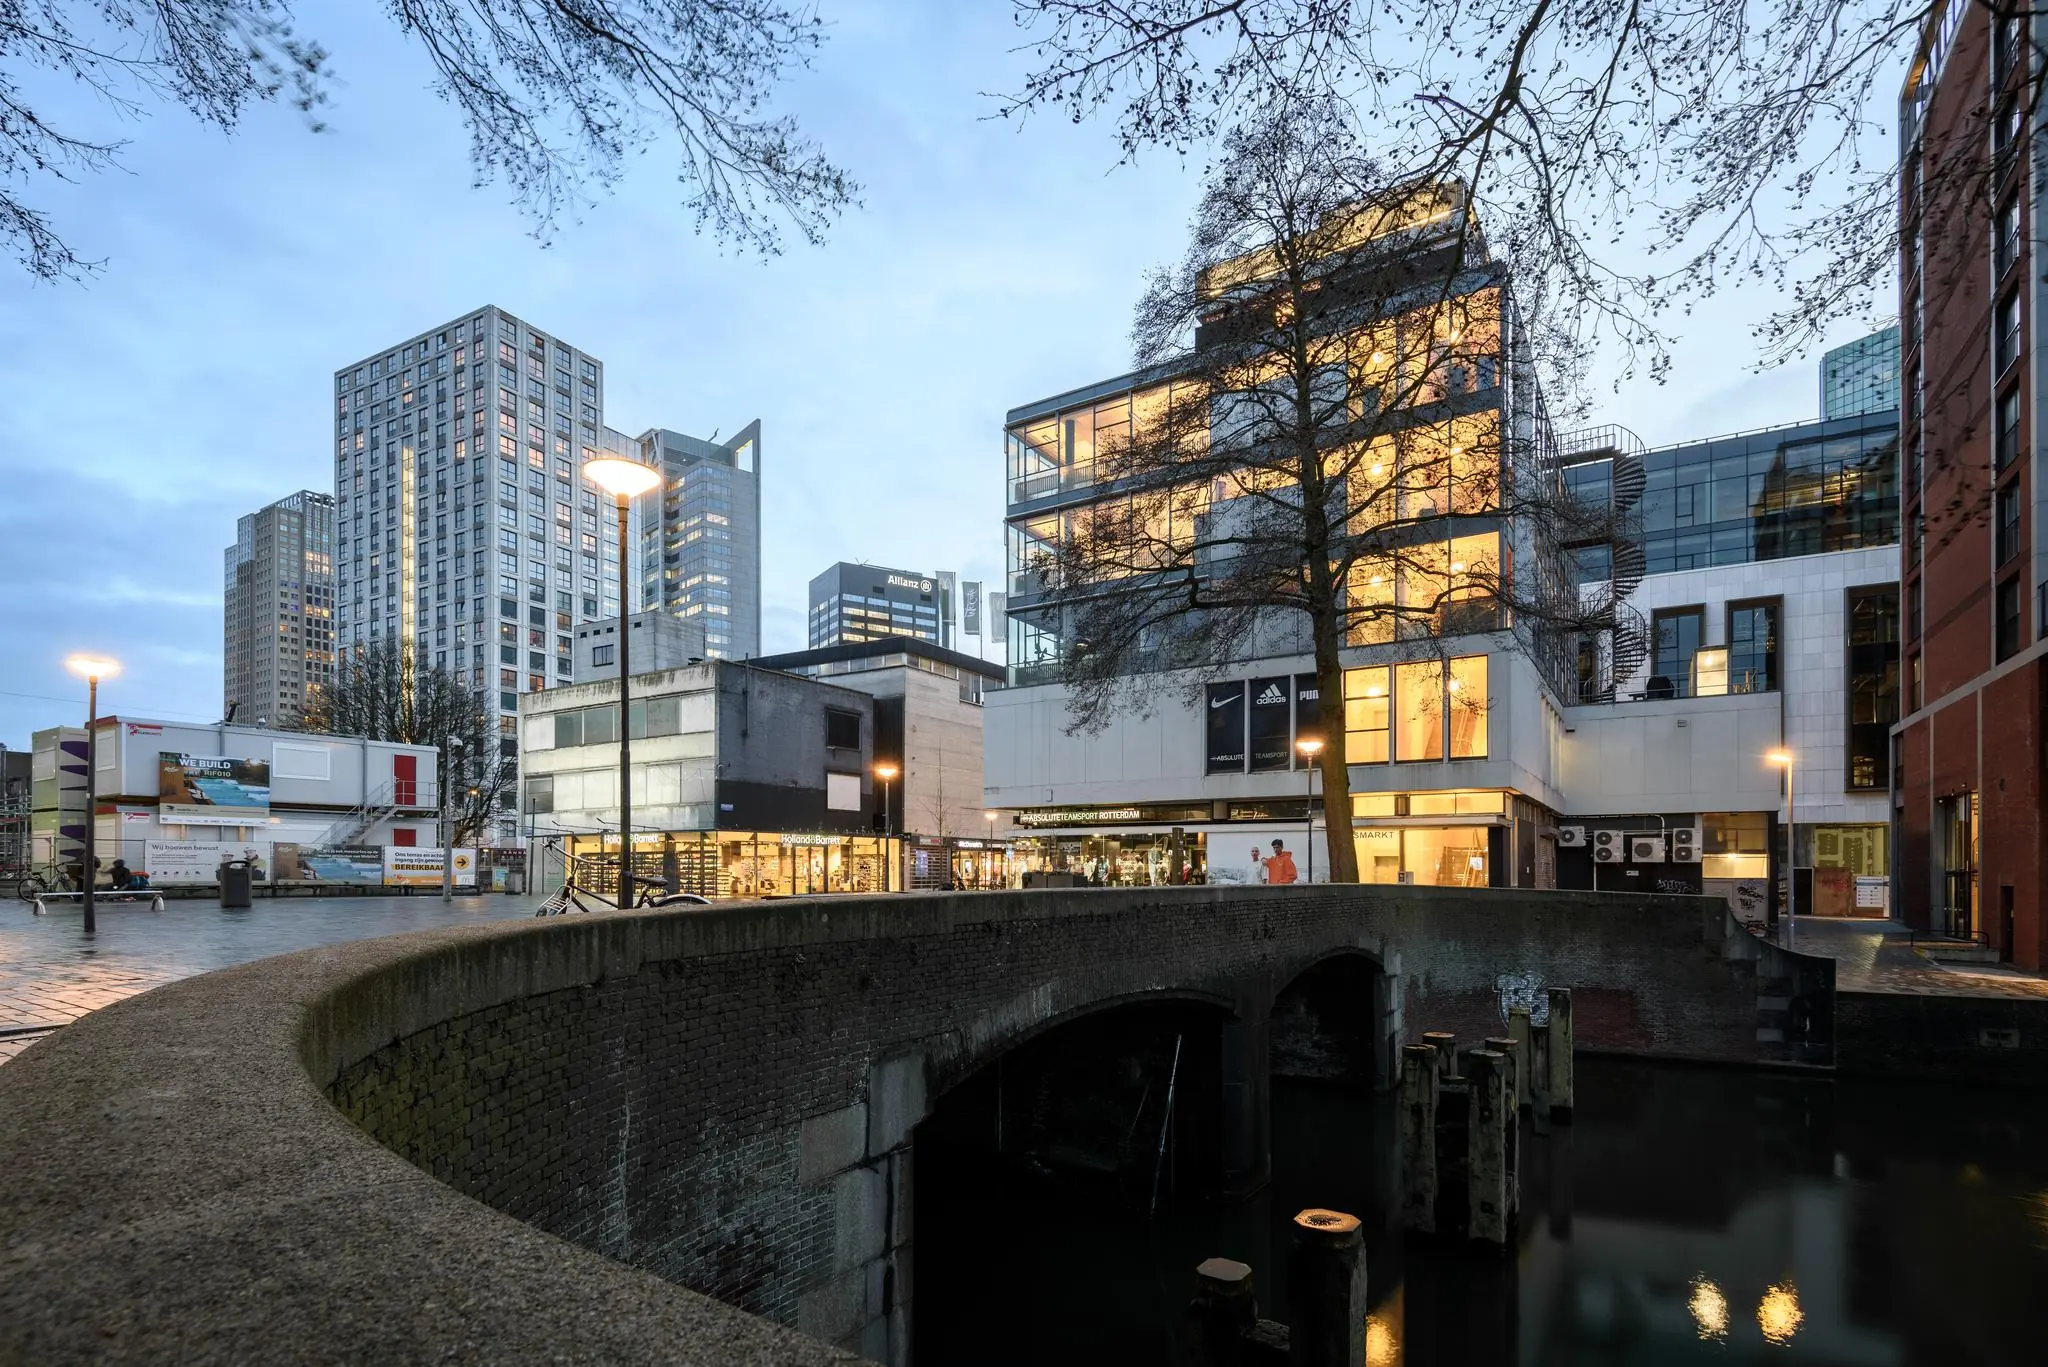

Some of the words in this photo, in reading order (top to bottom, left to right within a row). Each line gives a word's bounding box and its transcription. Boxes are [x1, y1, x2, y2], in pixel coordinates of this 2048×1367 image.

[887, 575, 919, 588] Allianz
[1256, 695, 1286, 704] adidas
[1299, 689, 1319, 700] PUM
[1255, 751, 1287, 759] TEAMSPORT
[179, 758, 196, 767] WE
[199, 760, 231, 769] BUILD
[1099, 810, 1140, 820] ROTTERDAM
[1353, 831, 1394, 839] SMARKT
